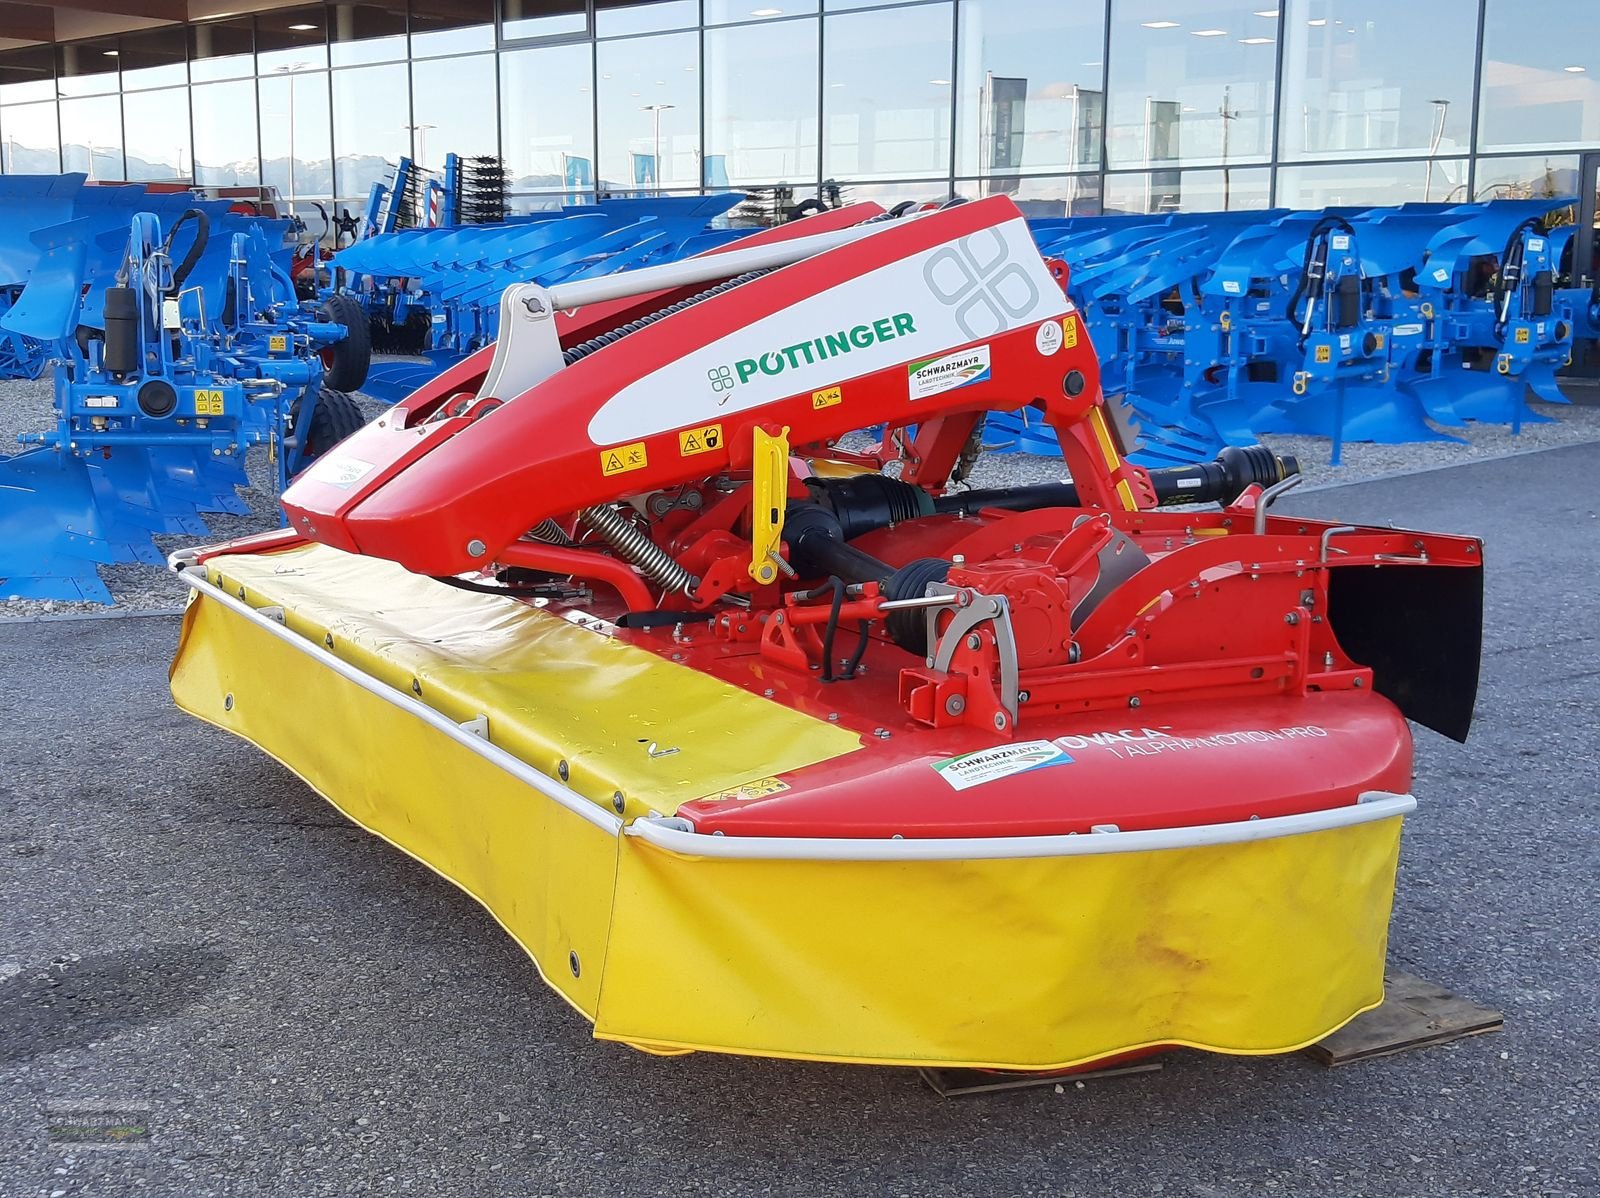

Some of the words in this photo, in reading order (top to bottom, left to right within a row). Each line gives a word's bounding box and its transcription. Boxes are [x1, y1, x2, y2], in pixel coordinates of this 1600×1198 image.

[916, 356, 979, 379] SCHWARZMAYR
[1280, 725, 1328, 739] PRO
[948, 746, 1041, 772] SCHWARZMAYR
